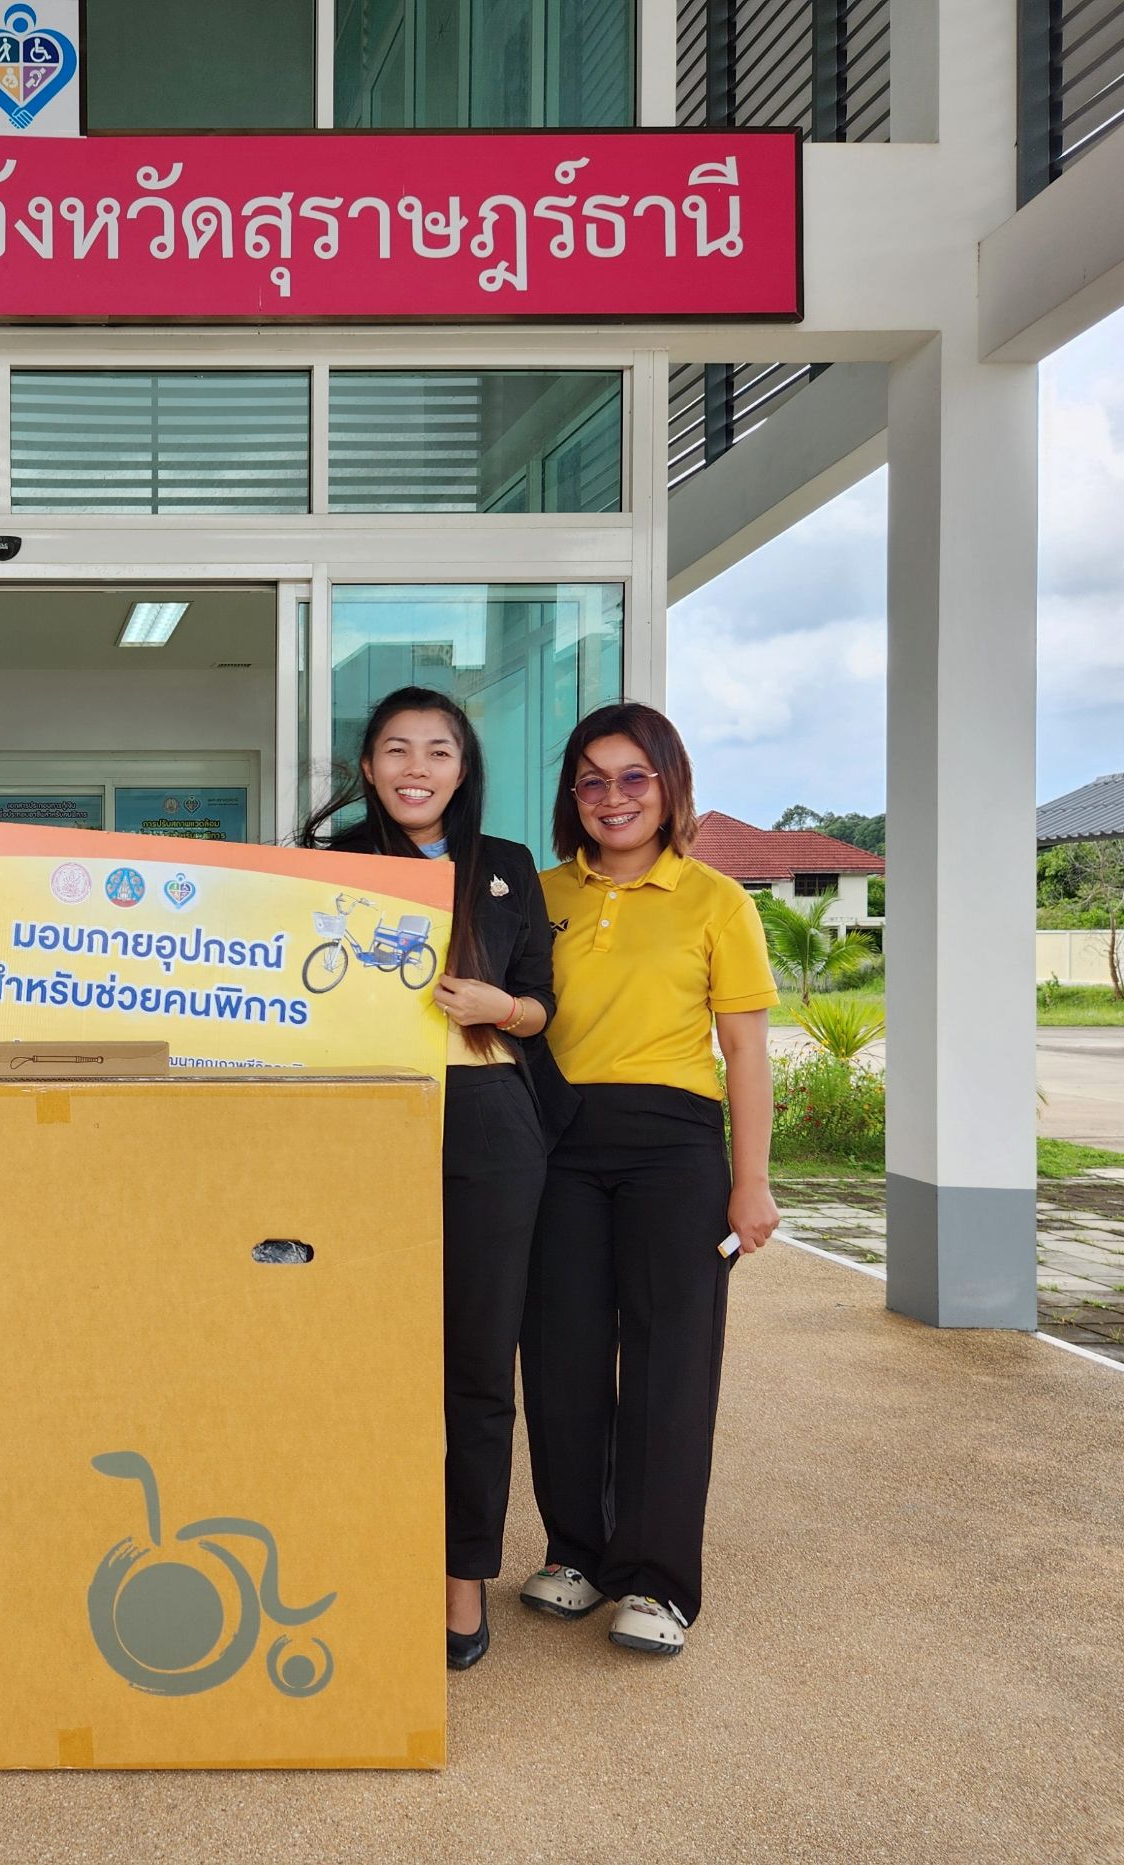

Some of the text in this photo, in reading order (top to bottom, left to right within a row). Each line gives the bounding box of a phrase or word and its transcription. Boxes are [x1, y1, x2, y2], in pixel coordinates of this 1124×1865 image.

[13, 922, 285, 972] มอบกายอุปกรณ์
